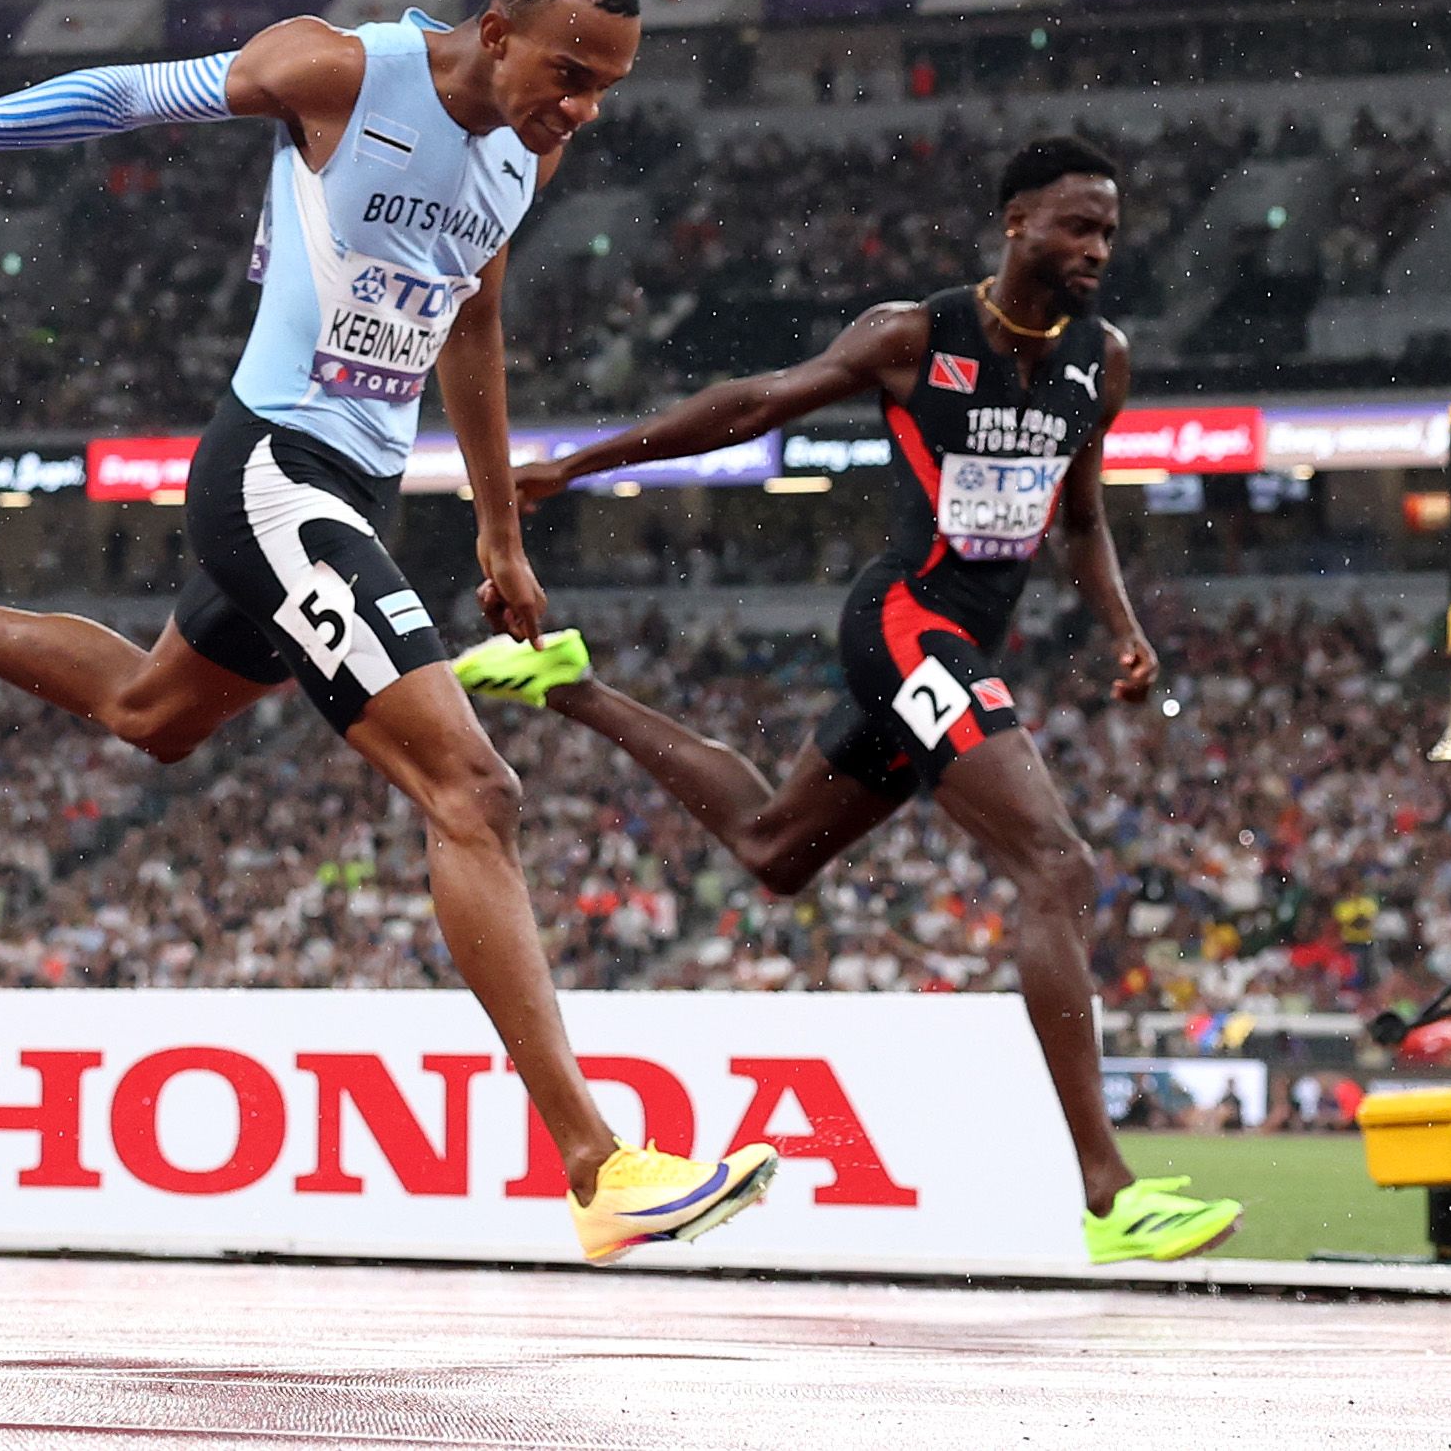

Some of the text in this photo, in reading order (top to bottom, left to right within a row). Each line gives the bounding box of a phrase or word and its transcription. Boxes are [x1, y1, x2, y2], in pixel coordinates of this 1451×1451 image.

[988, 464, 1062, 494] TDK
[299, 589, 346, 652] 5
[911, 685, 951, 725] 2
